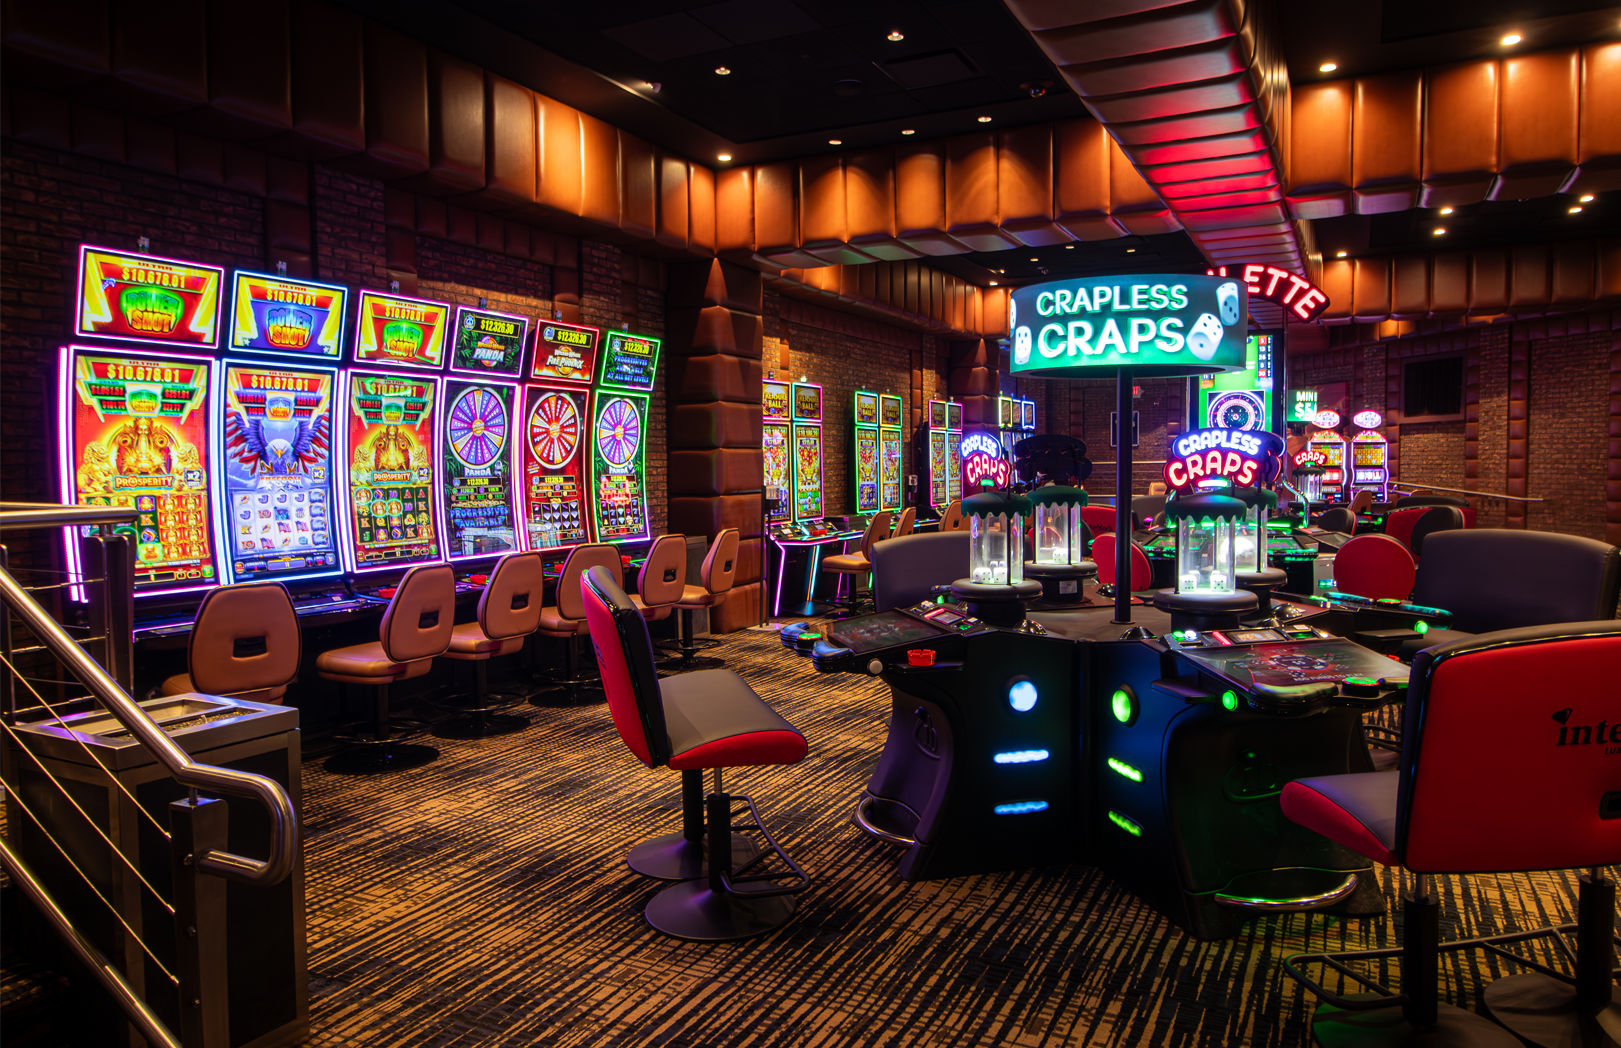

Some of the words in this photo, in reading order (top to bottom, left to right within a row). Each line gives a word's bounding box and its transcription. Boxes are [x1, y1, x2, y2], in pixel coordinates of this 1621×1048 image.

[1036, 284, 1188, 317] CRAPLESS
[131, 309, 172, 333] SHOT
[272, 325, 306, 346] SHOT
[1038, 317, 1185, 359] CRAPS
[473, 348, 505, 362] PANDA
[614, 355, 648, 367] PROGRESSIVES
[768, 399, 781, 408] BALL
[961, 434, 998, 458] CRAPLESS
[1178, 430, 1262, 456] CRAPLESS
[1295, 451, 1326, 466] CRAPS
[464, 467, 492, 477] PANDA
[608, 466, 629, 475] PANDA
[967, 454, 1006, 485] CRAPS
[1168, 450, 1258, 486] CRAPS
[115, 476, 173, 487] PROSPERITY
[449, 506, 509, 520] PROGRESSIVES
[459, 517, 503, 529] AVAILABLE
